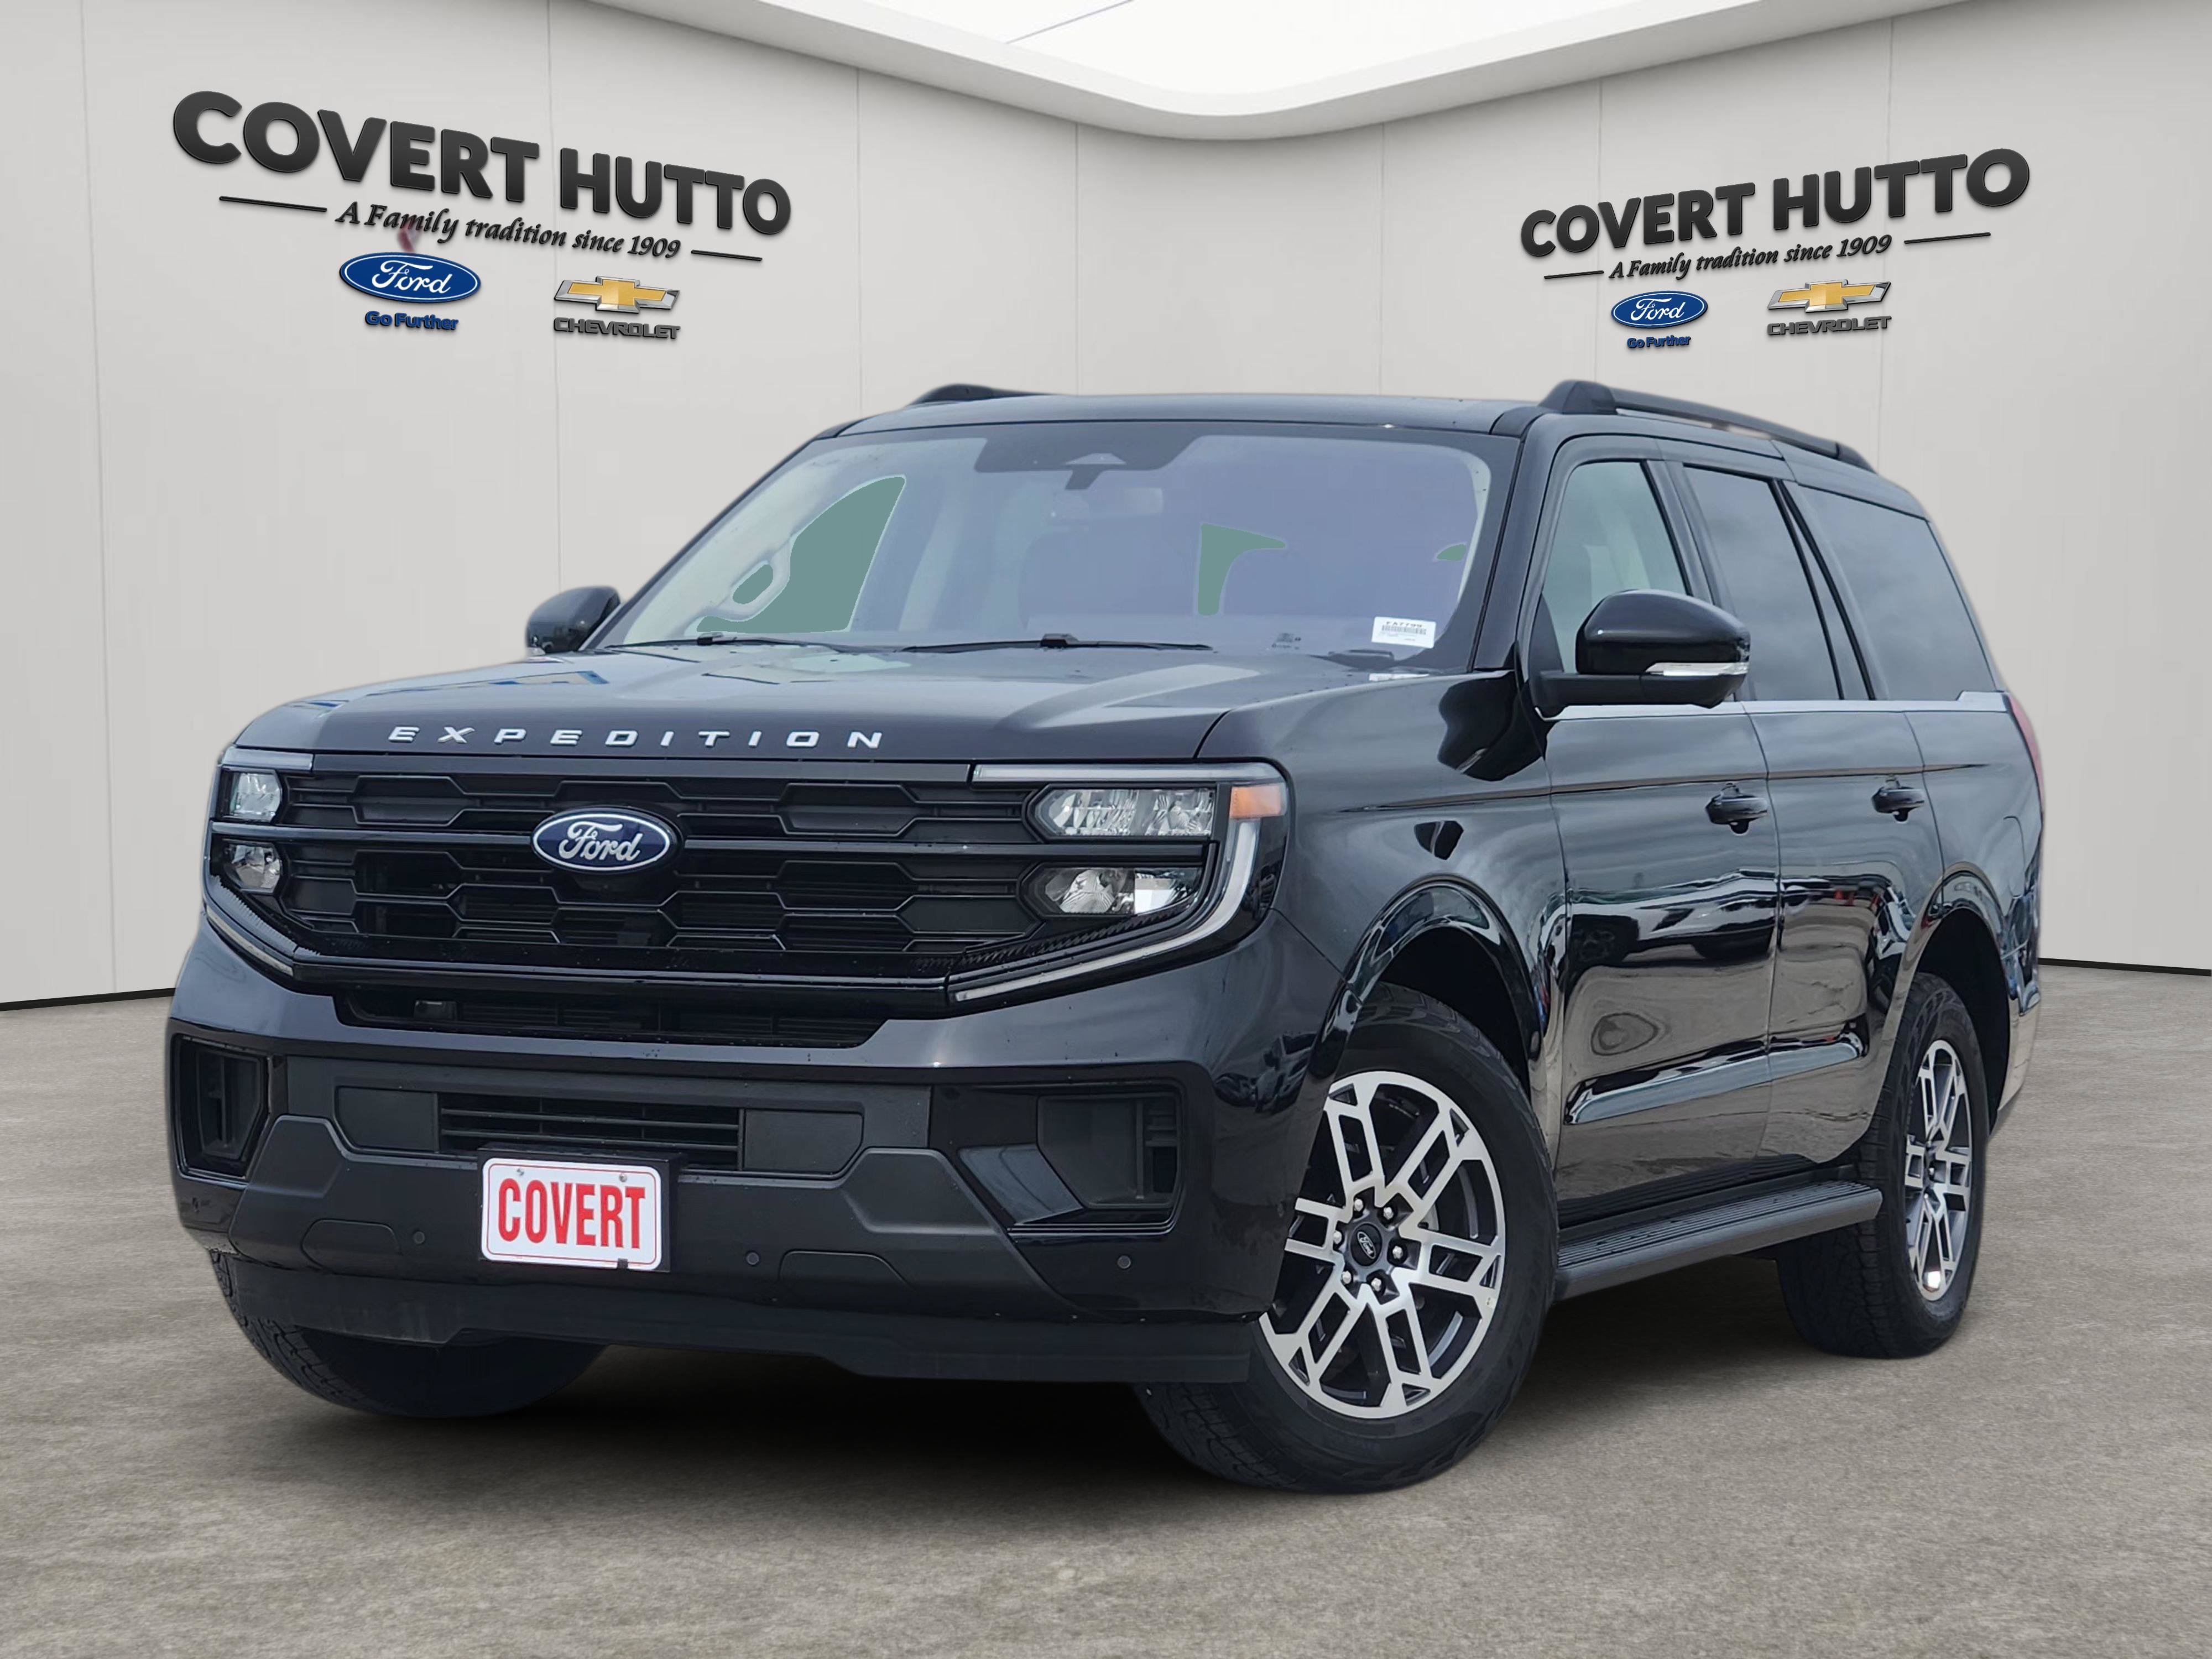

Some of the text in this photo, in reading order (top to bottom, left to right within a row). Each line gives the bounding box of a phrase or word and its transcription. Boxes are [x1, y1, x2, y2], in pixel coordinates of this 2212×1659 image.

[173, 91, 791, 234] COVERT HUTTO
[1521, 148, 2030, 257] COVERT HUTTO
[335, 201, 681, 258] A Family tradition since 1909
[1609, 234, 1892, 280] A Family tradition since 1909
[371, 259, 453, 294] Ford
[365, 310, 458, 331] Go Further
[1630, 298, 1686, 321] Ford
[1767, 316, 1892, 336] CHEVROLET
[553, 317, 681, 340] CHEVROLET
[1626, 333, 1691, 348] Go Further
[388, 726, 882, 749] EXPEDITION
[557, 821, 644, 862] Ford
[498, 1178, 646, 1249] COVERT
